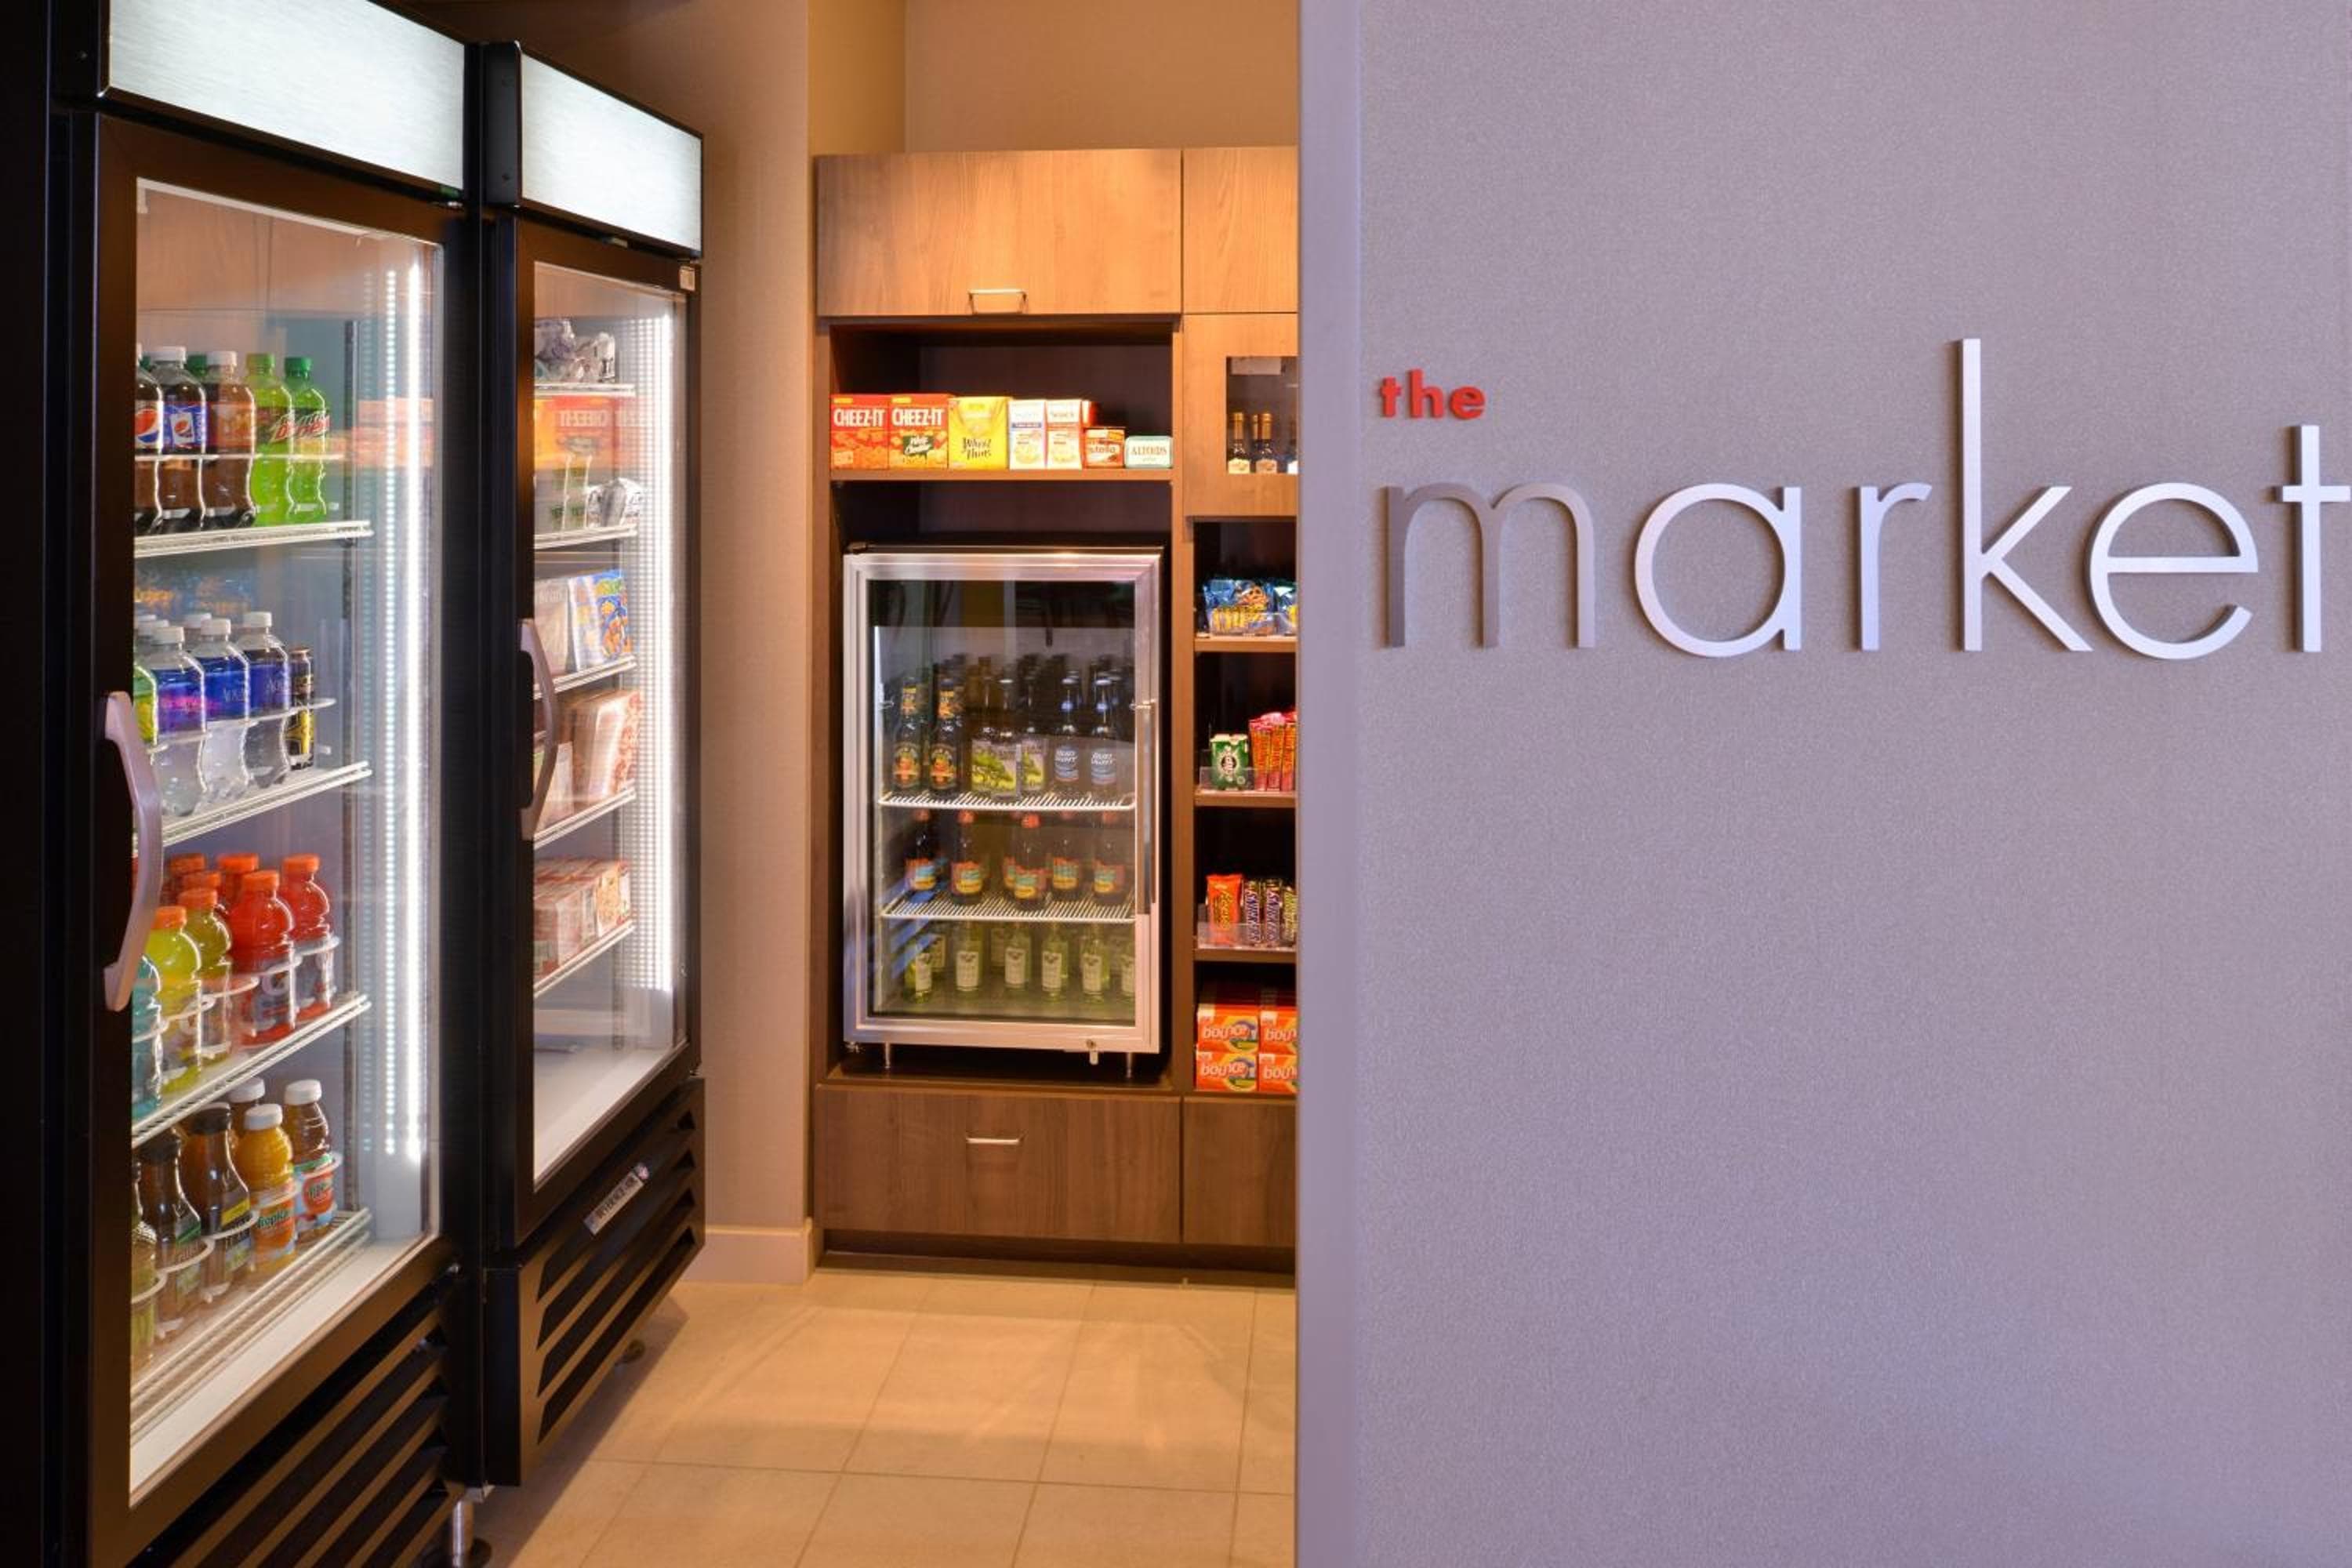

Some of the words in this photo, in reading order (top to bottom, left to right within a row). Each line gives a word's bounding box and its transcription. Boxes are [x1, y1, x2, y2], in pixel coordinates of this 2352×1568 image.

[1380, 368, 1486, 420] the
[833, 408, 885, 427] CHEEZ-IT
[891, 407, 945, 426] CHEEZ-IT
[1382, 337, 2351, 659] market
